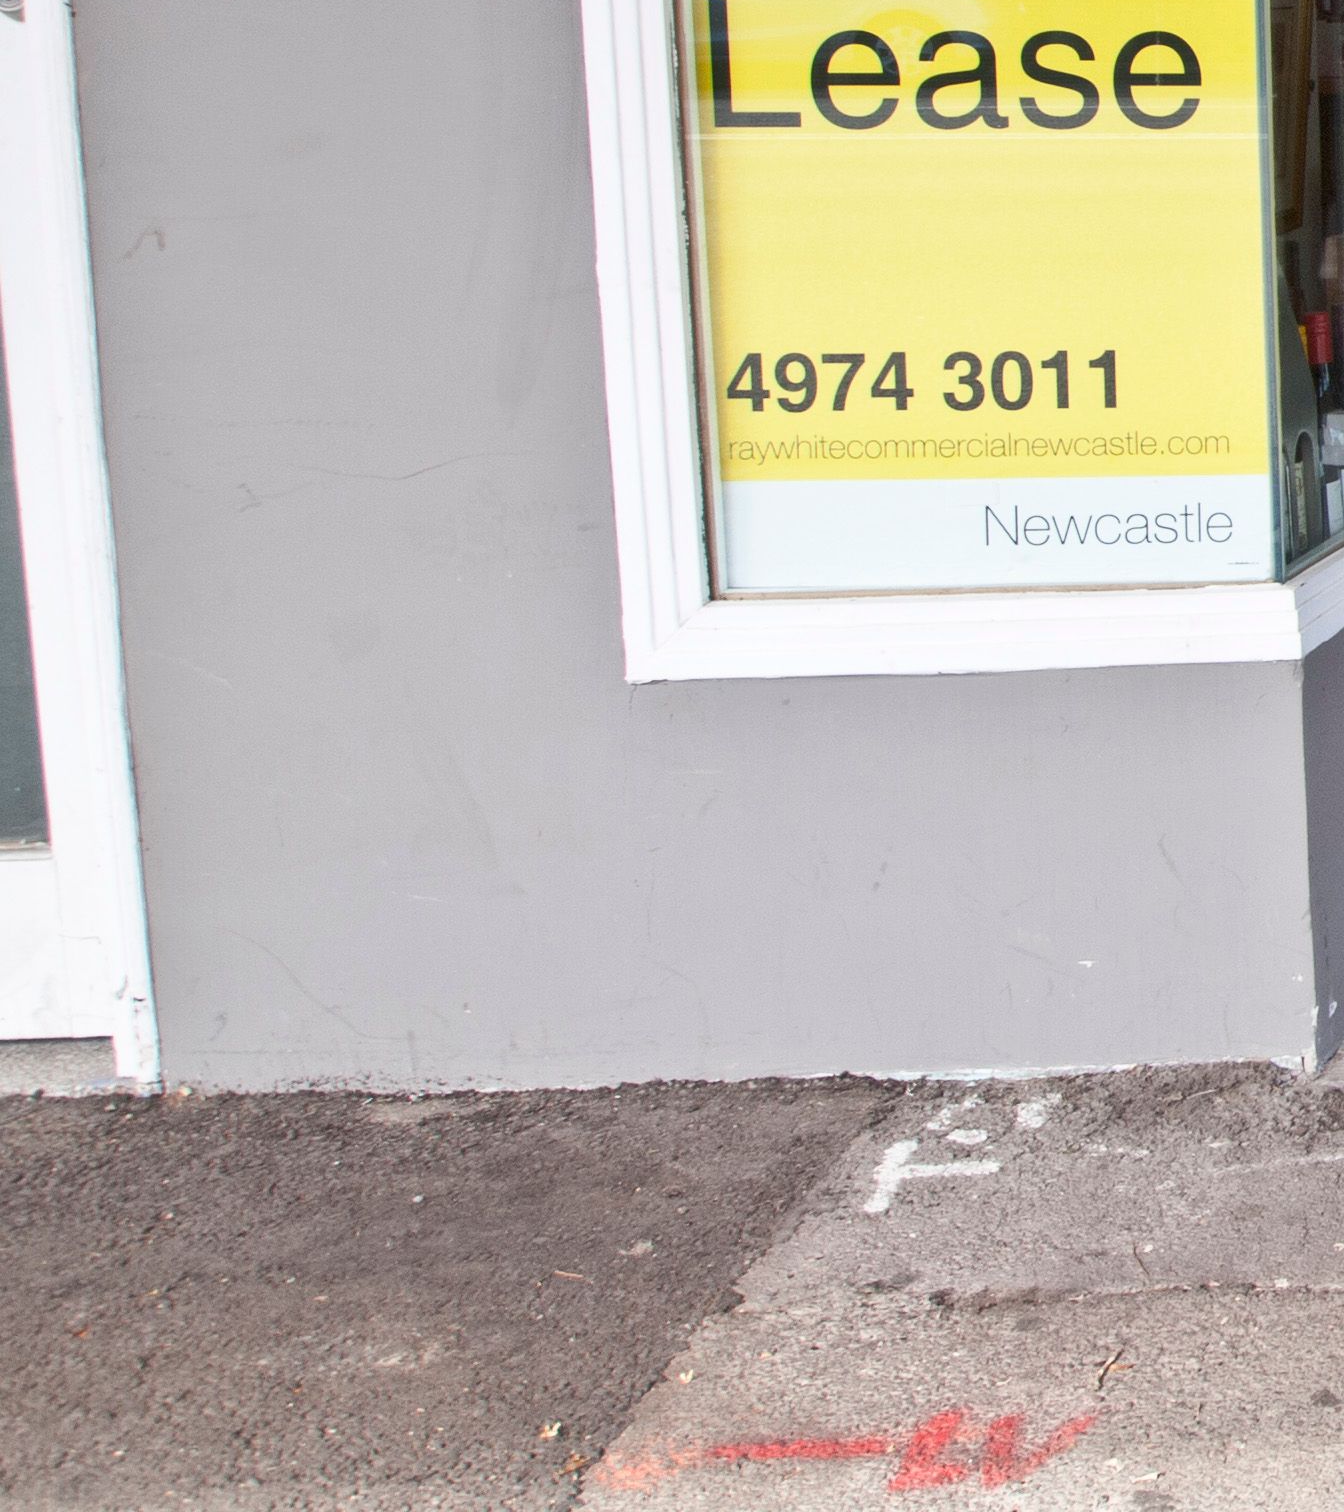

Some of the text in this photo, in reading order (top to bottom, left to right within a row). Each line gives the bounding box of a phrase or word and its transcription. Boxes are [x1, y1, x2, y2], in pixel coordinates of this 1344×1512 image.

[726, 349, 1120, 414] 4974 3011
[728, 430, 1231, 467] raywhitecommercialnewcastle.com
[984, 502, 1234, 546] Newcastle
